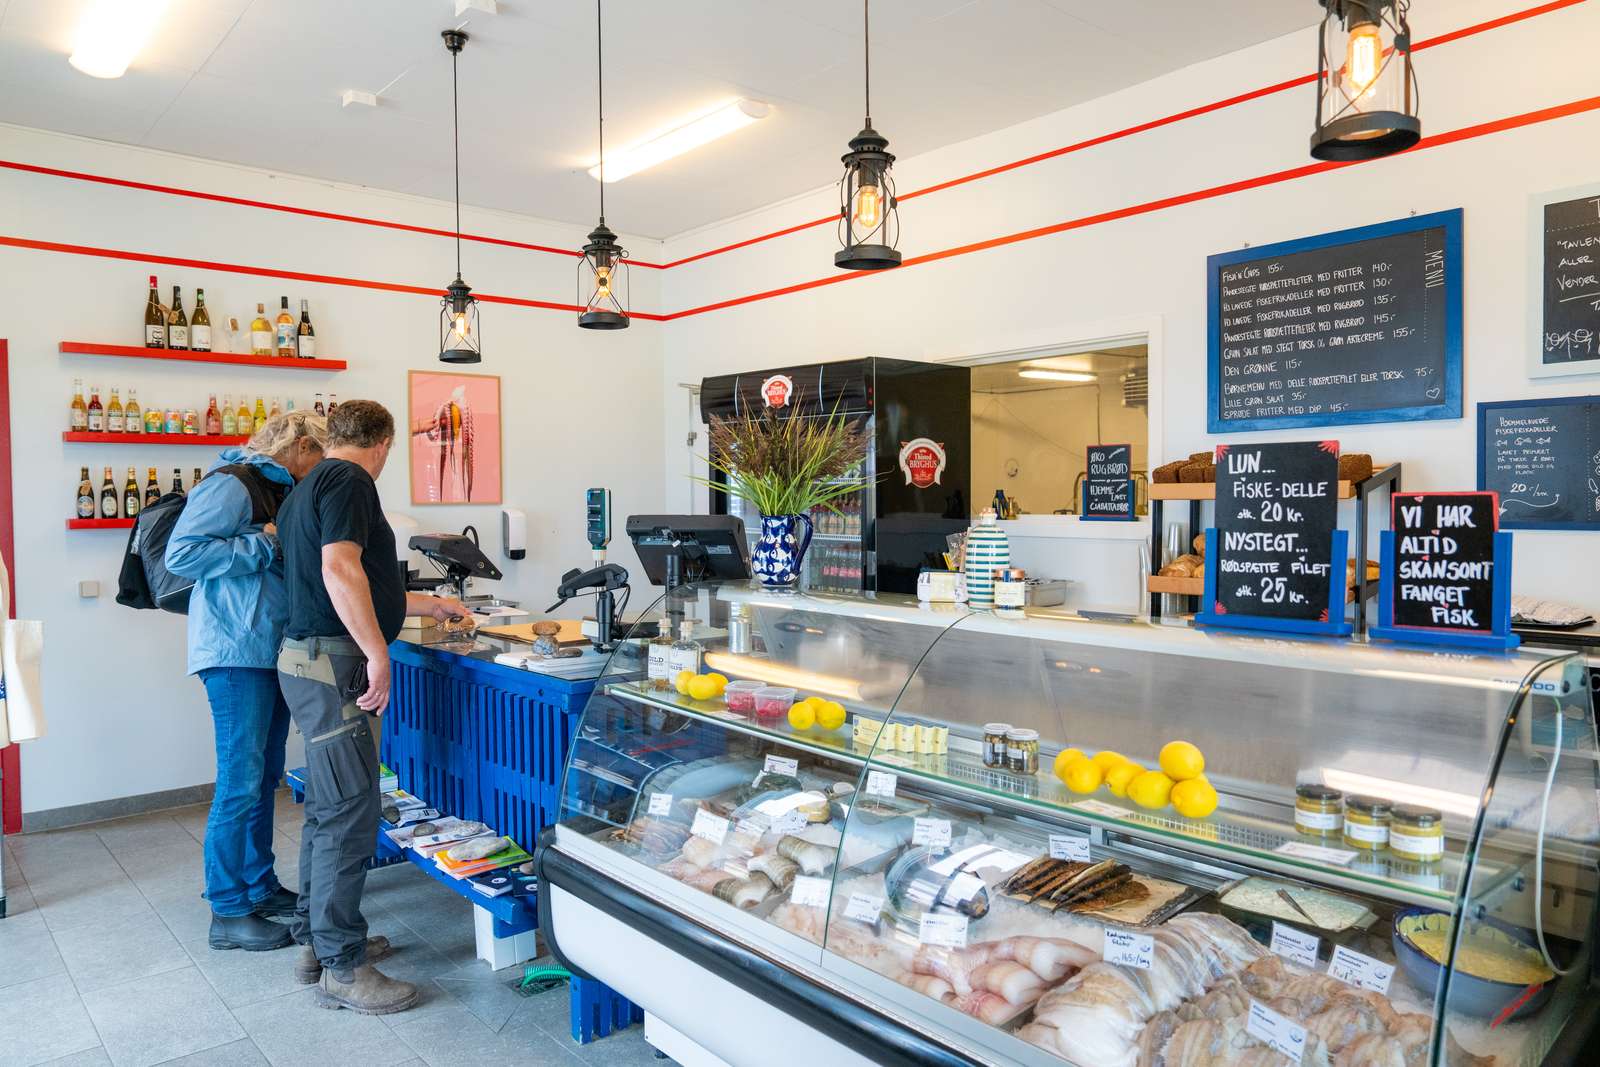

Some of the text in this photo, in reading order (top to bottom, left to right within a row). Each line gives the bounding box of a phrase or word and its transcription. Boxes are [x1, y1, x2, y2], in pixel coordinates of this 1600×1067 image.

[1425, 249, 1444, 288] MENU
[1558, 255, 1594, 268] ALLER
[1317, 272, 1330, 282] MED
[1334, 266, 1362, 279] FRITTER
[1256, 290, 1314, 306] FISKEFRIKADELLER
[1317, 287, 1330, 296] MED
[1334, 280, 1366, 294] FRITTER
[1256, 306, 1312, 322] FISKEFRIKADELLER
[1317, 304, 1330, 313] MED
[1334, 298, 1364, 310] RUGBRØD
[1318, 320, 1331, 332] MED
[1334, 316, 1364, 330] RUGBRØD
[1262, 344, 1272, 354] MED
[1276, 342, 1295, 352] STEGT
[1224, 366, 1240, 376] DEN
[1244, 362, 1278, 374] GRØNNE
[1224, 382, 1264, 395] BØRNEMENU
[1269, 380, 1282, 390] MED
[1288, 378, 1306, 388] DELLE
[1360, 372, 1378, 382] ELLER
[1380, 370, 1404, 380] TORSK
[1224, 398, 1242, 408] LILLE
[1266, 394, 1284, 404] SALAT
[1224, 409, 1252, 420] SPRØDE
[1256, 406, 1285, 416] FRITTER
[1288, 406, 1304, 414] MED
[1309, 404, 1322, 414] DIP
[1260, 500, 1282, 522] 20
[1400, 504, 1477, 528] VI HAR
[1400, 534, 1458, 554] ALTID
[1220, 560, 1332, 576] RØDSPÆTTE FILET
[1260, 577, 1288, 604] 25
[1400, 584, 1470, 607] FANGET
[1430, 605, 1479, 627] FISK
